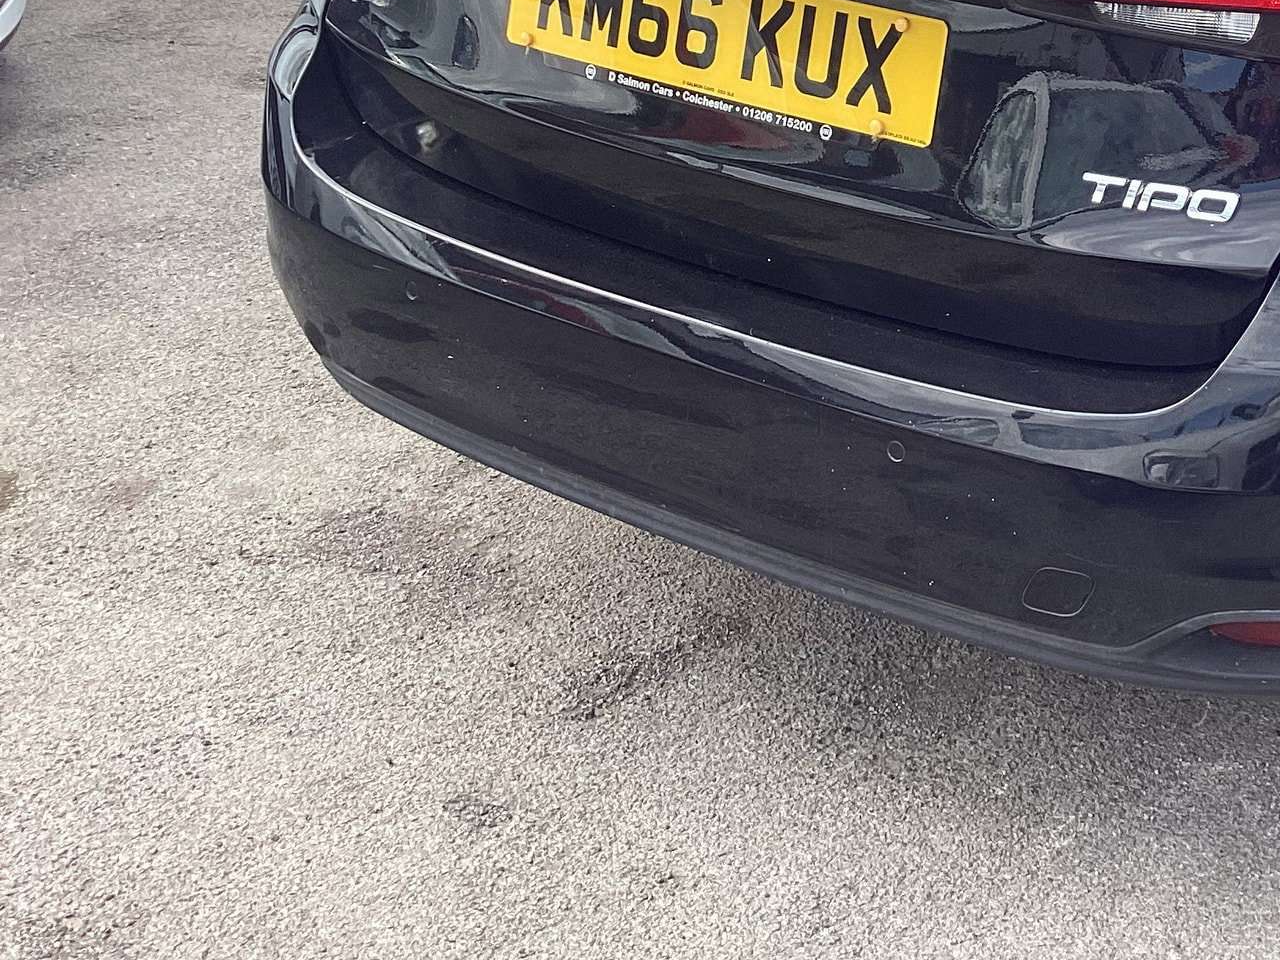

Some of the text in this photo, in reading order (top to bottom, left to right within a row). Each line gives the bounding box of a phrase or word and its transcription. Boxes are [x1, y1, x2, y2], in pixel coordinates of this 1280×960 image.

[608, 71, 813, 133] D Salmon Cars Colchester 01206 715200
[1082, 171, 1241, 223] TIPO
